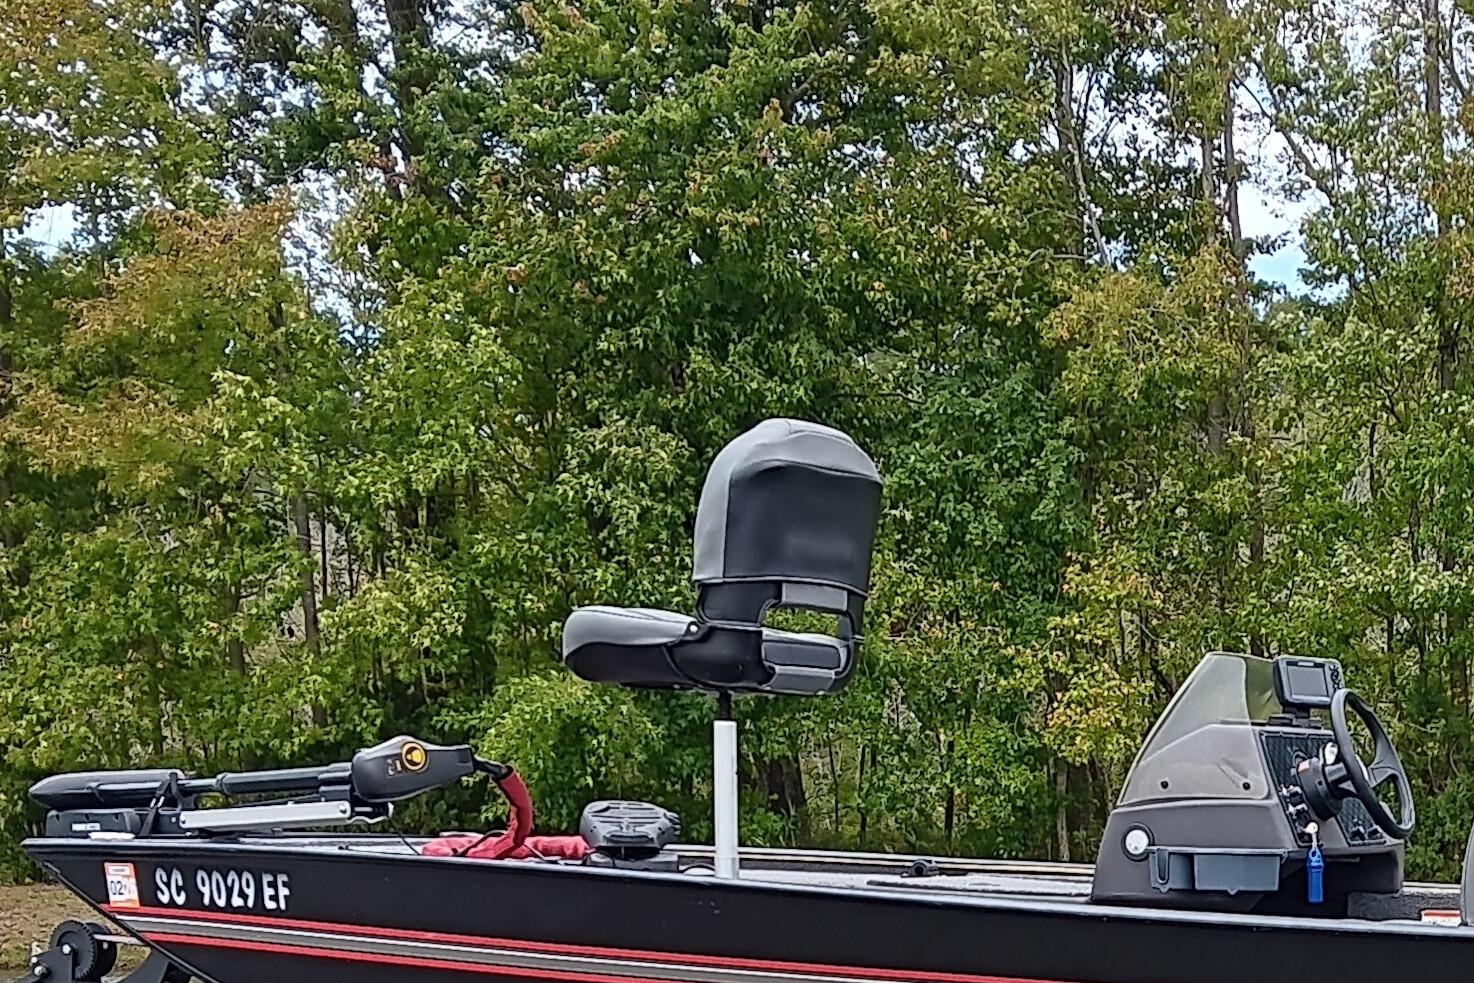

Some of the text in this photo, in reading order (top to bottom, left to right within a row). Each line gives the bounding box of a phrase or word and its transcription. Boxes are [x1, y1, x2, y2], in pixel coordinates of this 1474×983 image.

[155, 867, 186, 905] SC
[196, 869, 255, 908] 9029
[262, 872, 290, 910] EF
